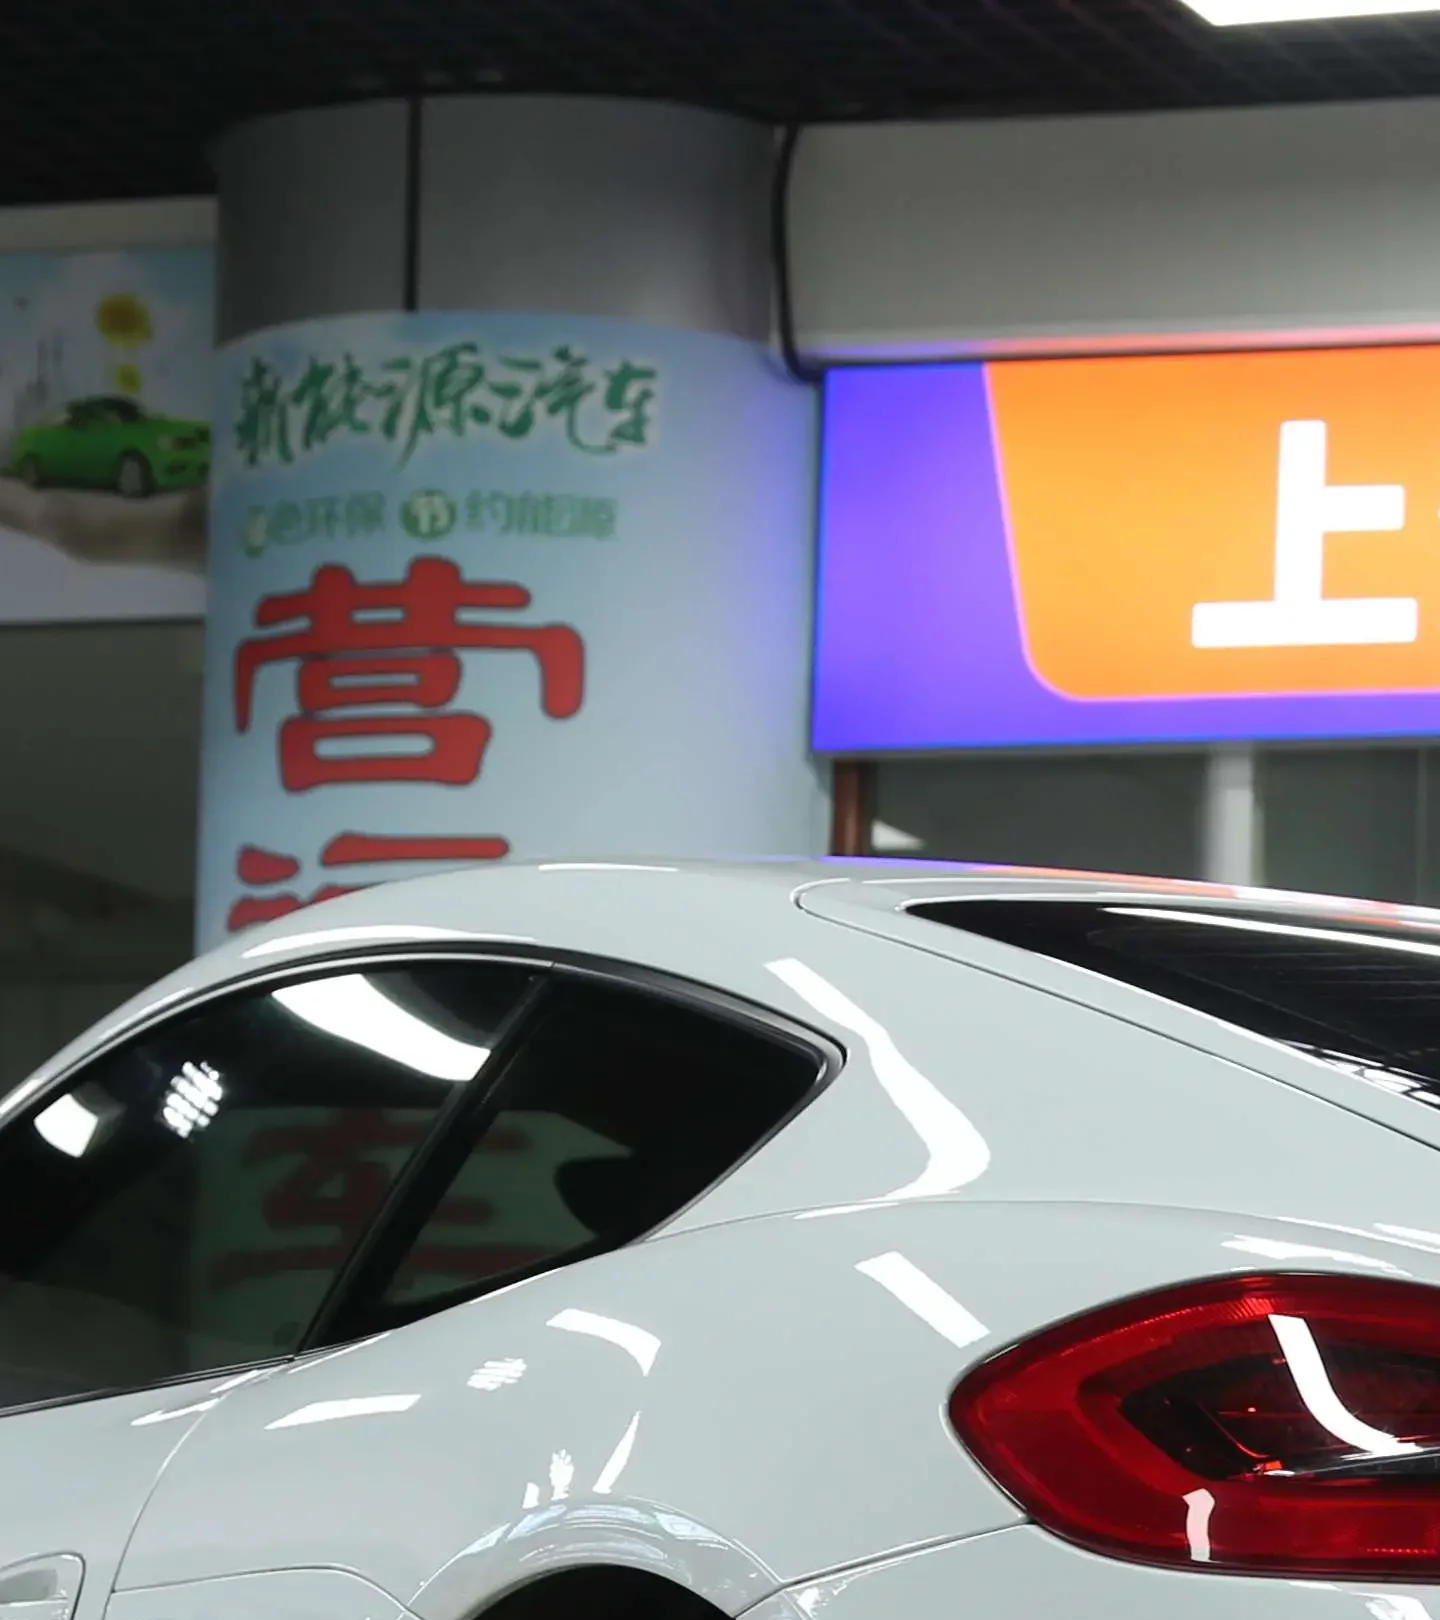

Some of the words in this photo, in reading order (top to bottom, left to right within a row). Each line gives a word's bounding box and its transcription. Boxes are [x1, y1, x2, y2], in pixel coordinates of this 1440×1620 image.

[235, 341, 658, 470] 新能源汽车
